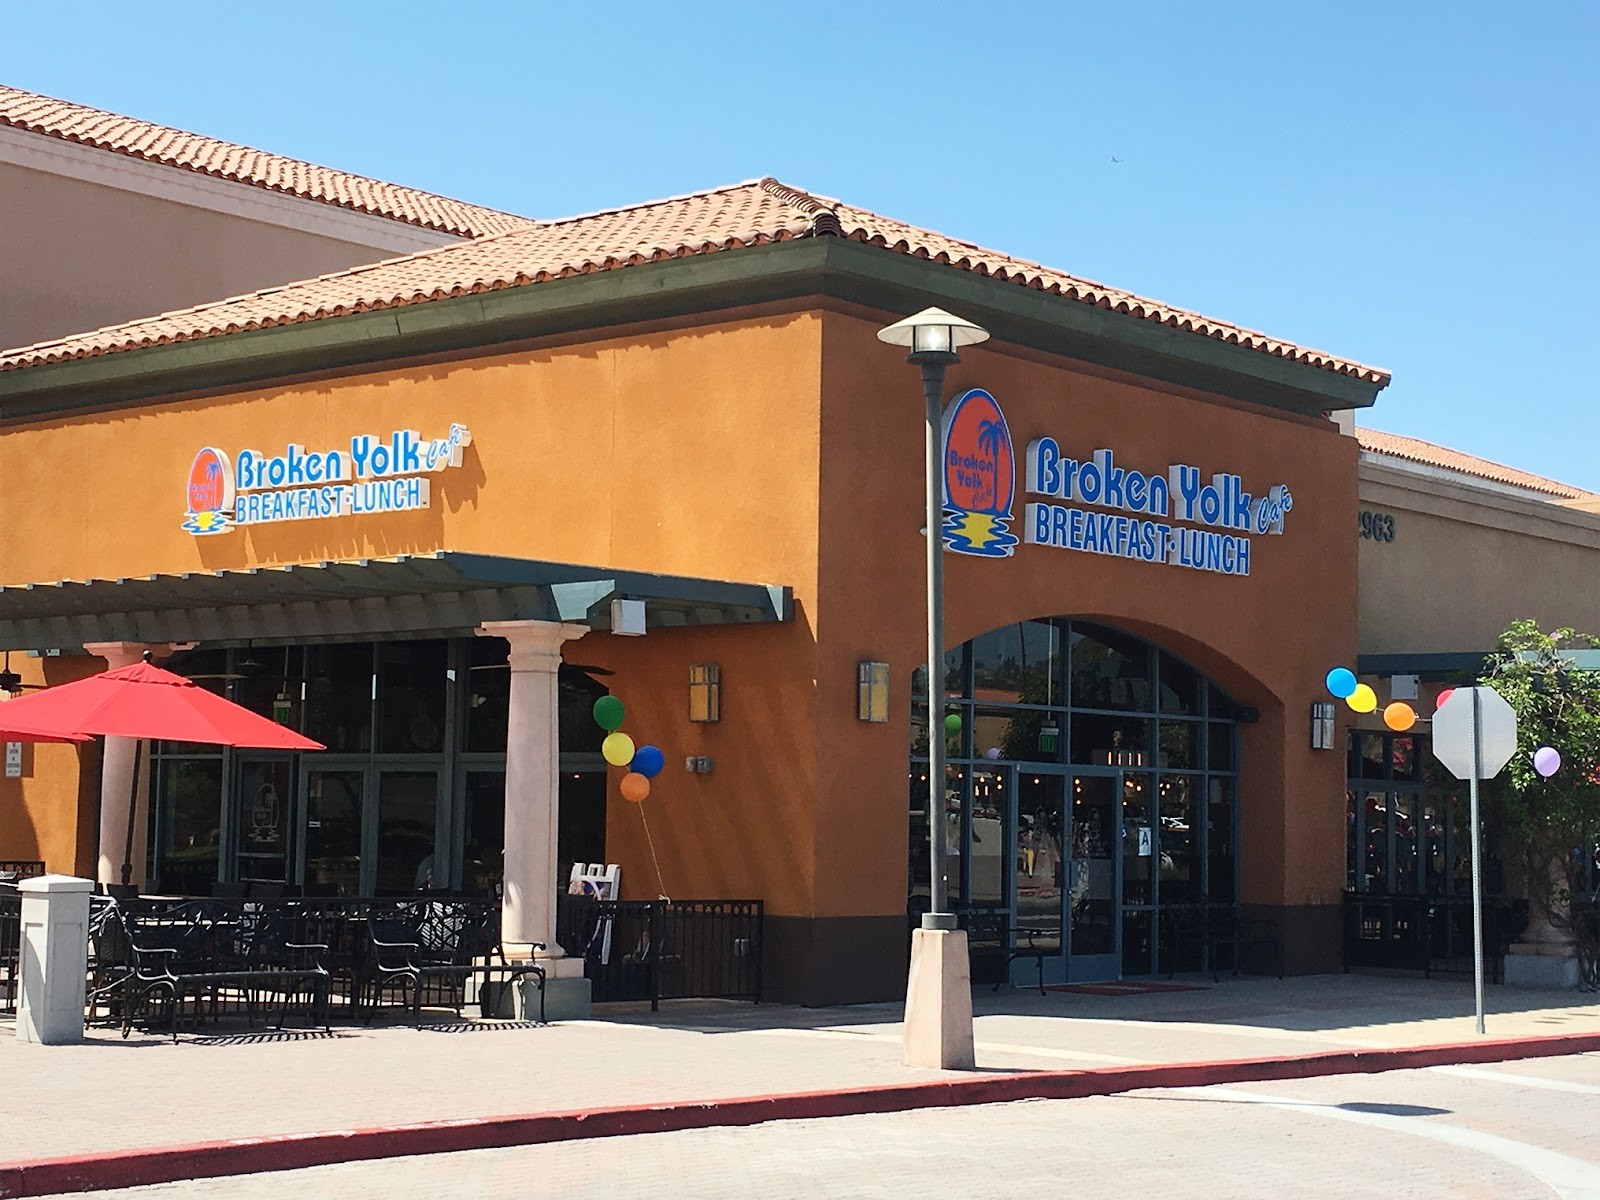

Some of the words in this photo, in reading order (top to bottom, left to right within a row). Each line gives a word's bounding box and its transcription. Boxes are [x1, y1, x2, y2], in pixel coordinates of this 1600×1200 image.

[237, 444, 341, 488] Broken
[352, 429, 419, 474] Yolk
[950, 449, 993, 472] Broken
[353, 478, 420, 511] LUNCH
[1037, 437, 1168, 516] Broken
[1179, 465, 1251, 530] Yolk
[1180, 528, 1250, 576] LUNCH
[1141, 831, 1149, 846] A
